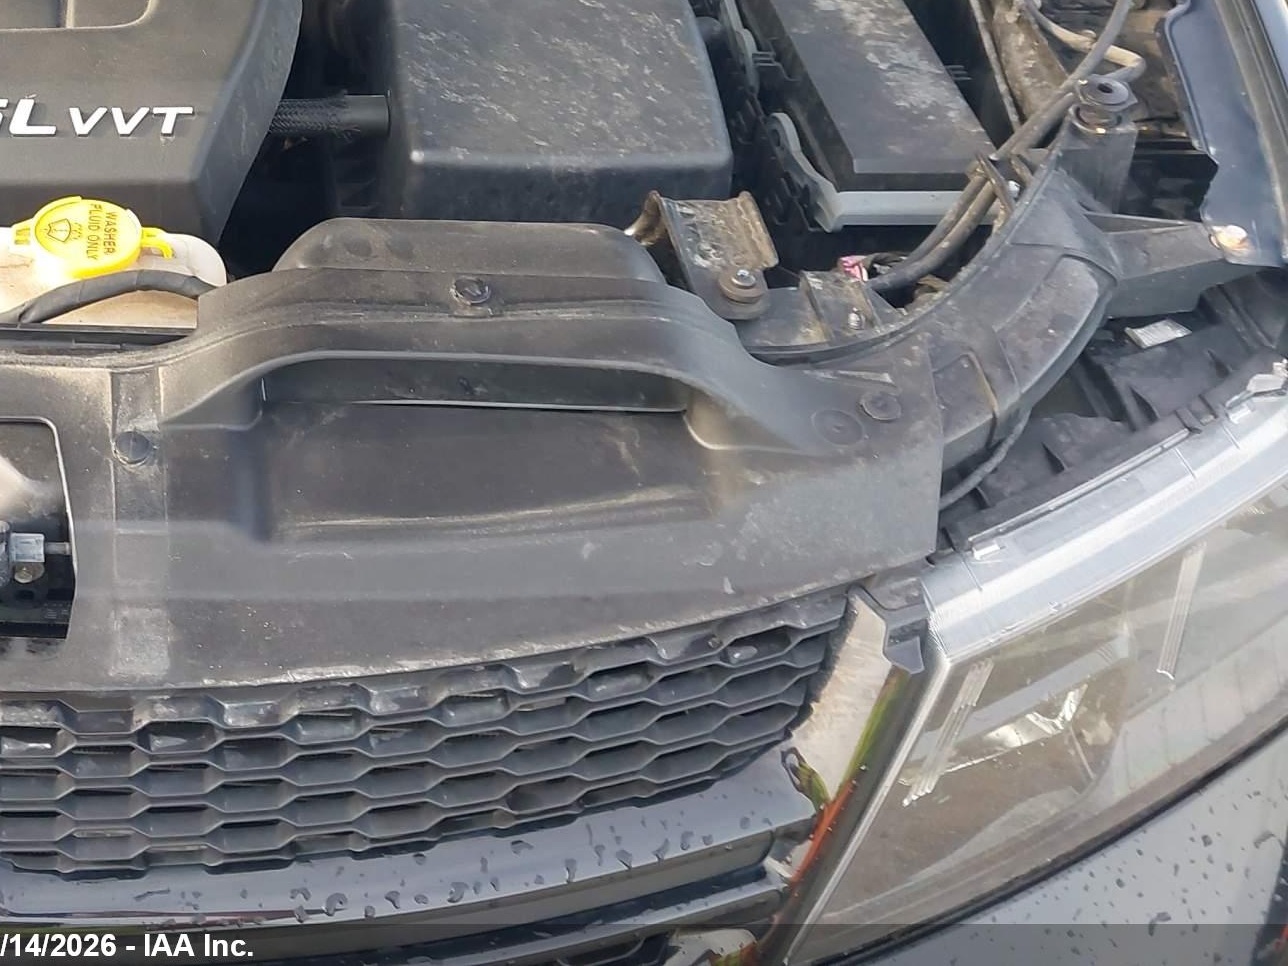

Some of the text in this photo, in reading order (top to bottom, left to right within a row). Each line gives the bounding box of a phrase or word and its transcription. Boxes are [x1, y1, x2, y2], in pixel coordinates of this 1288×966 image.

[68, 106, 194, 137] VVT
[86, 203, 103, 260] FLUID ONLY
[103, 212, 117, 255] WASHER
